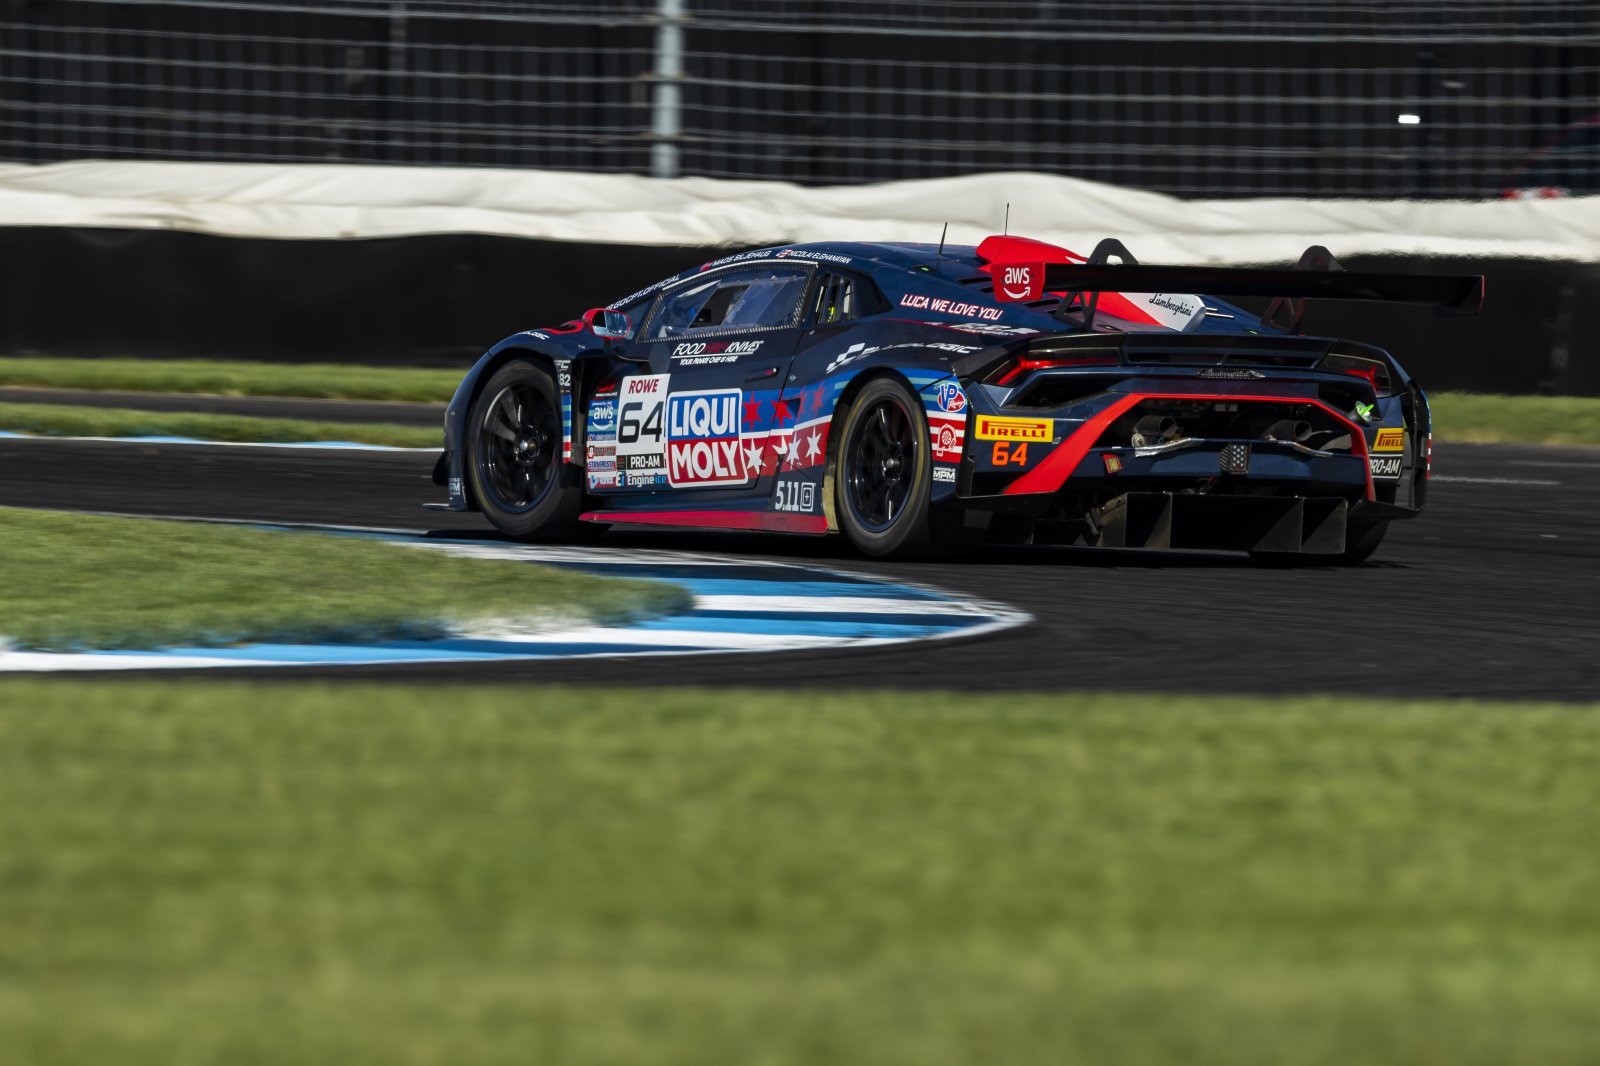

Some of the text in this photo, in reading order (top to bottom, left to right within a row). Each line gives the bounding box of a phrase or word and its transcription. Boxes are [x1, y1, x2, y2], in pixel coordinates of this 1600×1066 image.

[712, 250, 772, 267] MADS SILJEHAUG
[788, 249, 813, 259] NICOLAI
[1004, 267, 1030, 285] aws
[900, 293, 1004, 321] LUCA WE LOVE YOU
[1148, 293, 1195, 317] Lamborghini
[672, 342, 707, 356] FOOD
[724, 340, 765, 353] KNIVES
[679, 358, 693, 366] YOUR
[628, 378, 660, 395] ROWE
[940, 383, 959, 411] VP
[593, 406, 614, 420] aws
[671, 397, 737, 438] LIQUI
[618, 401, 664, 443] 64
[981, 420, 1047, 438] PIRELLI
[1377, 432, 1404, 447] PIRELL
[671, 440, 740, 480] MOLY
[991, 440, 1028, 466] 64
[630, 455, 661, 469] PRO-AM
[627, 473, 655, 488] Engine
[932, 470, 955, 480] MPM
